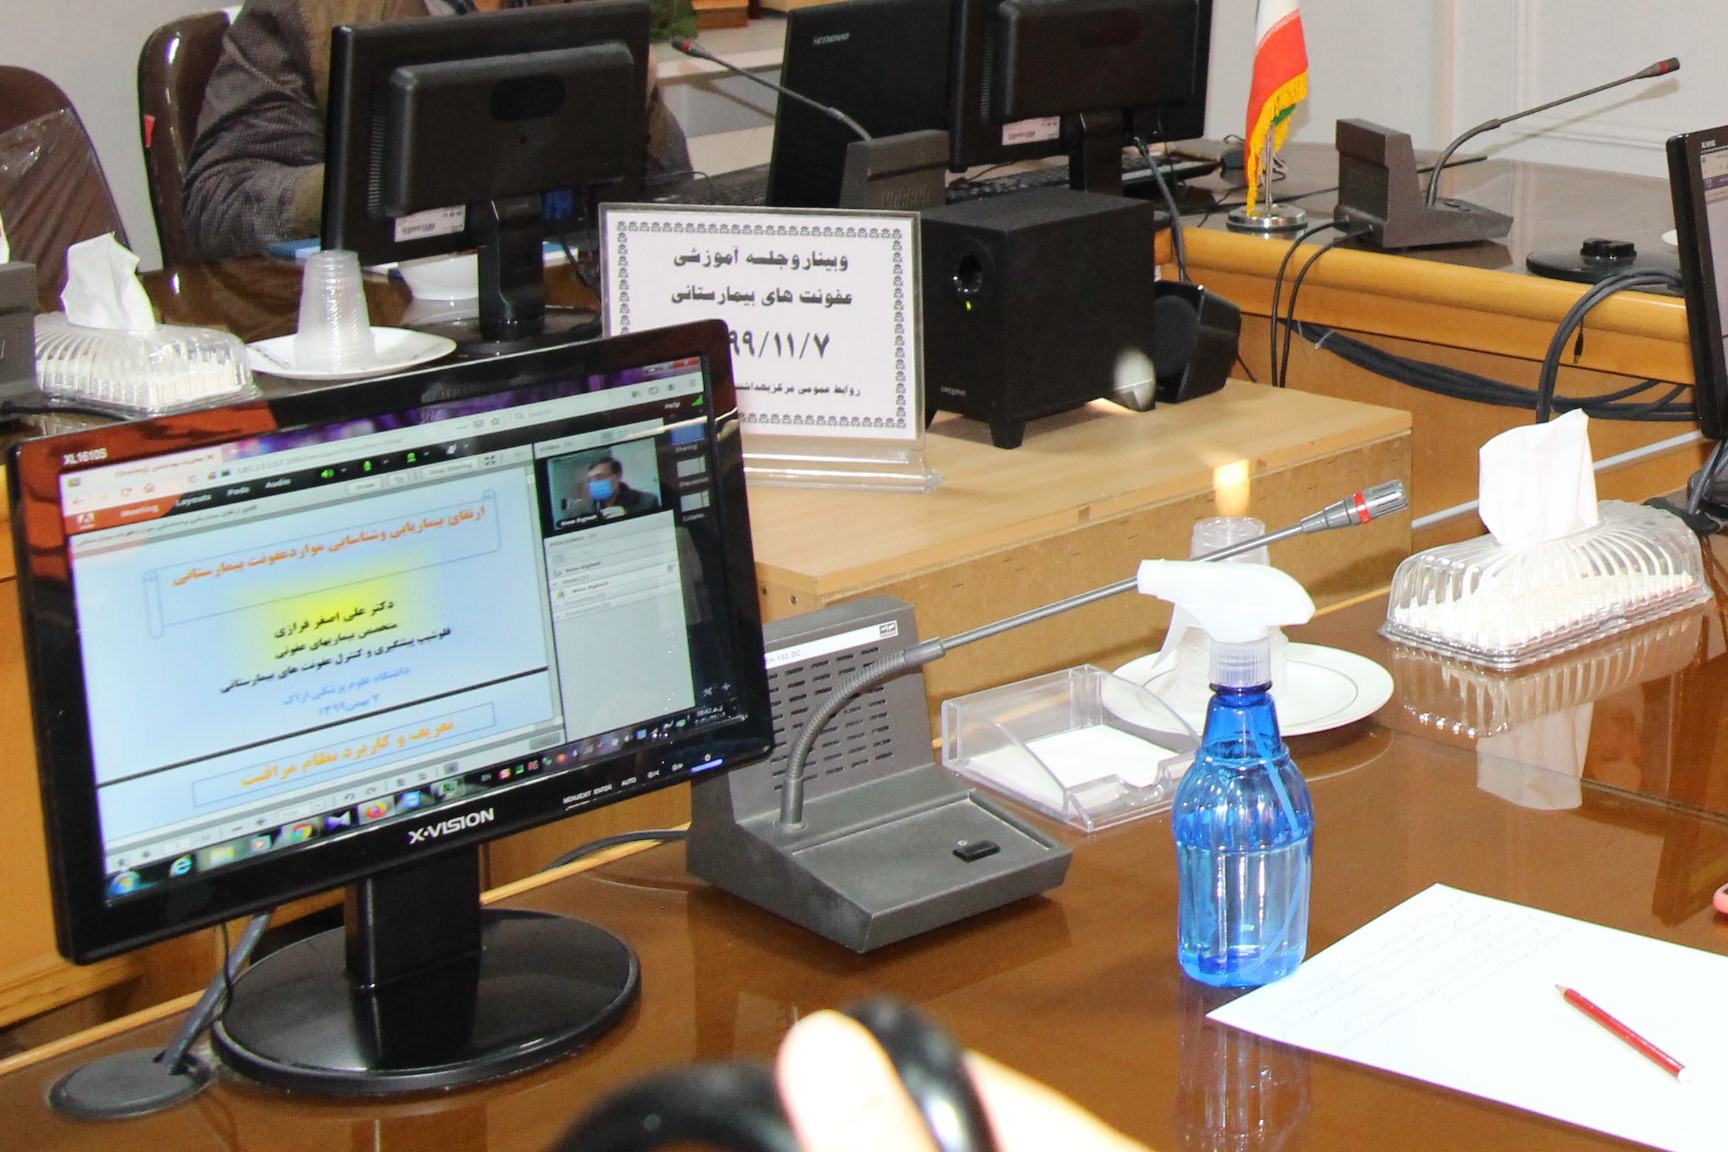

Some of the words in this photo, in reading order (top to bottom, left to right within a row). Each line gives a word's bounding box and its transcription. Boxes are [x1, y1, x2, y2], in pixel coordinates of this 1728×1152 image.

[673, 246, 739, 269] آموزشی
[671, 285, 755, 307] بیمارستانی
[761, 287, 793, 307] های
[799, 289, 853, 308] عفونت
[798, 386, 830, 396] عمومی
[833, 384, 860, 397] روابط
[120, 504, 160, 518] Meeting
[174, 493, 212, 508] Layouts
[264, 477, 292, 490] Audio
[172, 558, 244, 586] بیمارستانی
[343, 606, 366, 622] علی
[370, 600, 395, 617] دکتر
[274, 619, 310, 638] فرازی
[314, 611, 341, 630] اصغر
[358, 622, 398, 640] متخصص
[275, 643, 306, 659] عفونی
[334, 648, 363, 665] کنترل
[277, 665, 299, 680] های
[301, 657, 332, 672] عفونت
[220, 671, 275, 694] بیمارستانی
[408, 717, 454, 741] تعریف
[341, 733, 391, 761] کاربرد
[397, 735, 406, 749] و
[302, 750, 339, 773] نظام
[240, 763, 297, 787] مراقبت
[620, 776, 638, 787] AUTO
